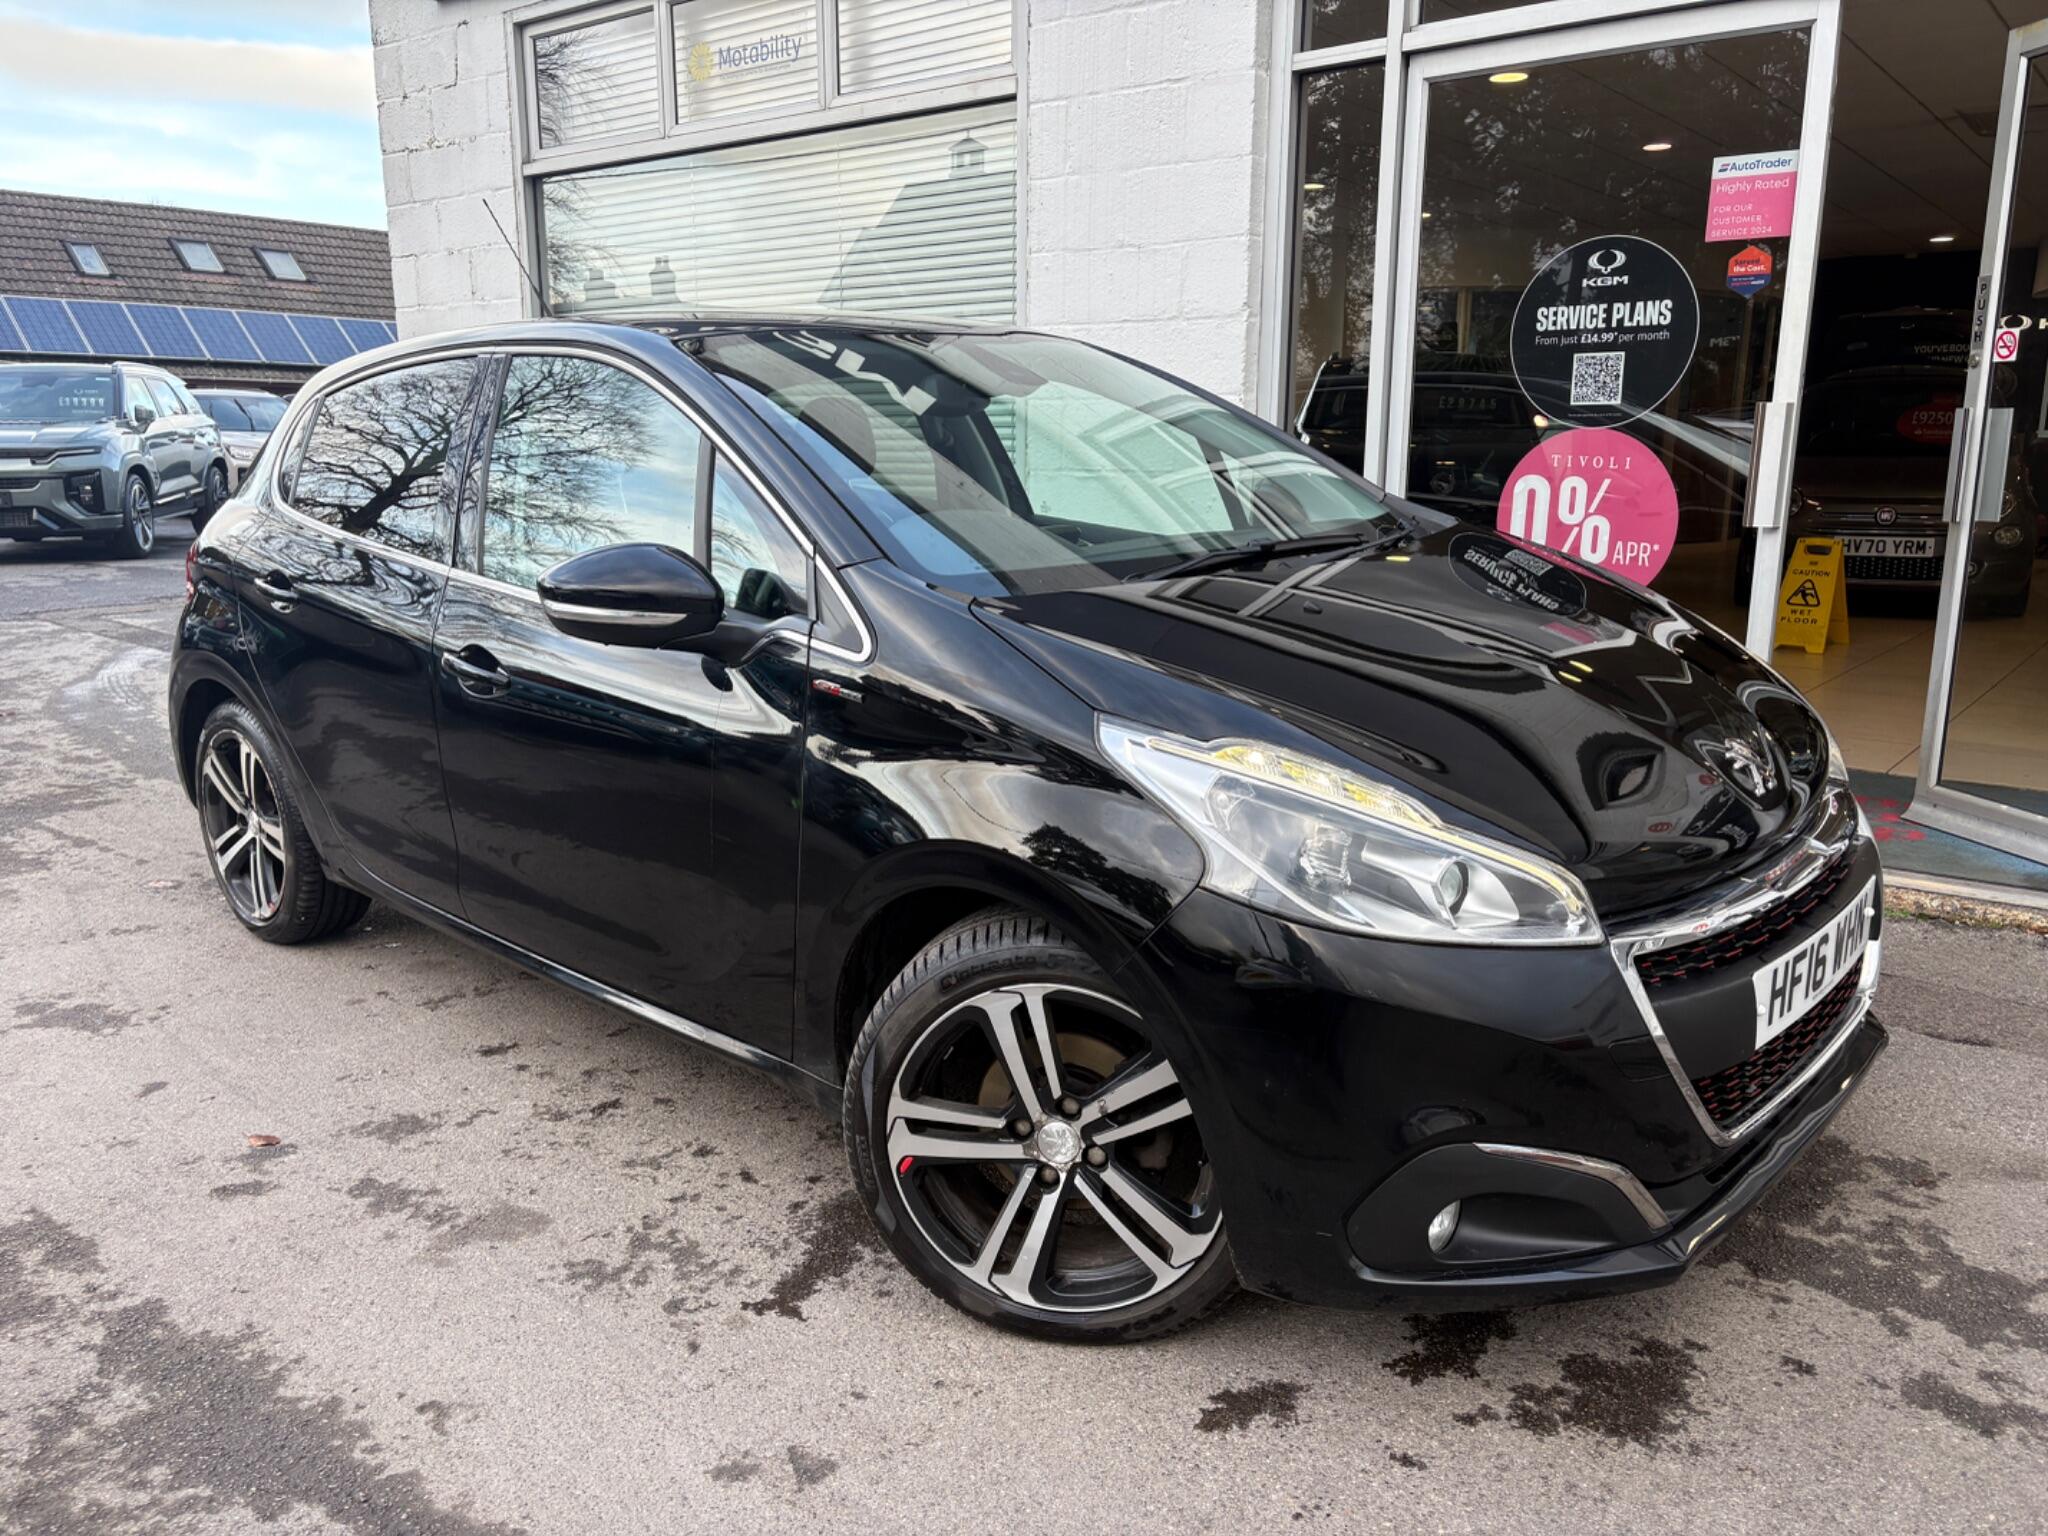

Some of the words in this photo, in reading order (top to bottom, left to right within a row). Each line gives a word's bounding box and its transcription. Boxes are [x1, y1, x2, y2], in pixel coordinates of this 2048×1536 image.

[719, 34, 802, 69] Motability
[1729, 158, 1793, 172] AutoTrader
[1716, 180, 1752, 195] Highly
[1755, 178, 1790, 190] Rated
[1713, 205, 1731, 213] FOR
[1733, 203, 1753, 211] OUR
[1712, 215, 1762, 225] CUSTOMER
[1711, 228, 1748, 238] SERVICE
[1750, 226, 1772, 235] 2024
[1582, 275, 1629, 288] KGM
[1536, 304, 1608, 332] SERVICE
[1612, 299, 1673, 328] PLANS
[1974, 283, 1987, 342] PUSH
[1535, 335, 1558, 345] From
[1560, 335, 1578, 347] just
[1618, 333, 1634, 345] per
[1637, 329, 1670, 342] month
[1551, 454, 1632, 470] TIVOLI
[1510, 474, 1612, 564] 0%
[1842, 538, 1887, 553] HV70
[1893, 539, 1927, 555] YRM
[1792, 568, 1831, 577] CAUTION
[1780, 616, 1818, 625] FLOOR
[1768, 932, 1829, 1027] HF16
